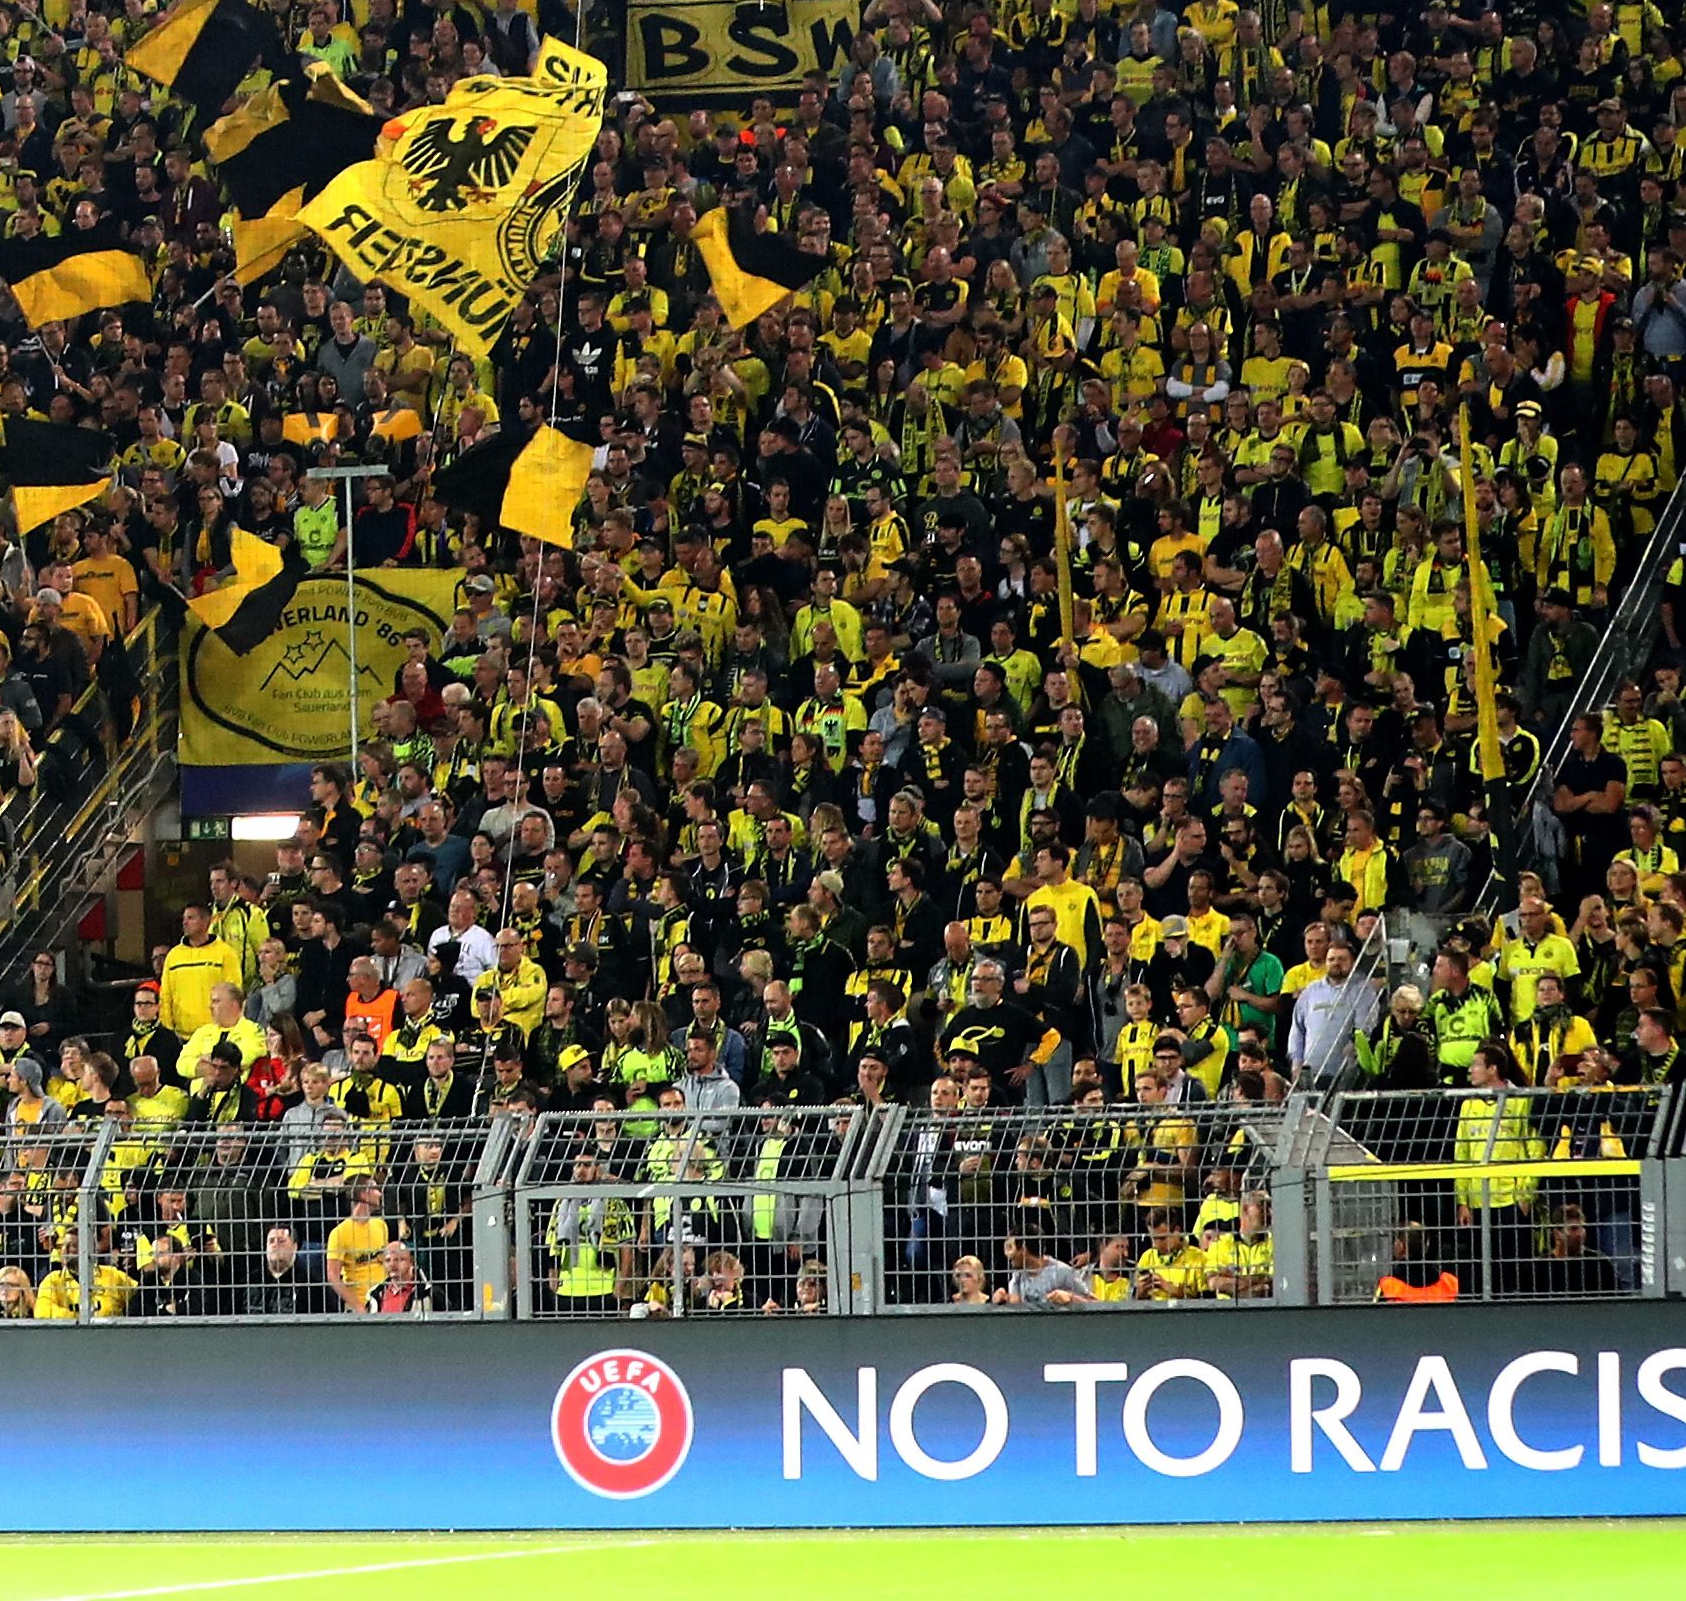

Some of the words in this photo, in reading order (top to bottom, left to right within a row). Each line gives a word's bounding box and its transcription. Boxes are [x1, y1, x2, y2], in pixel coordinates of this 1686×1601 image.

[296, 688, 322, 700] Club
[294, 702, 350, 714] Sauerland
[579, 1359, 661, 1394] UEFA
[782, 1363, 1008, 1481] NO
[1044, 1358, 1243, 1477] TO
